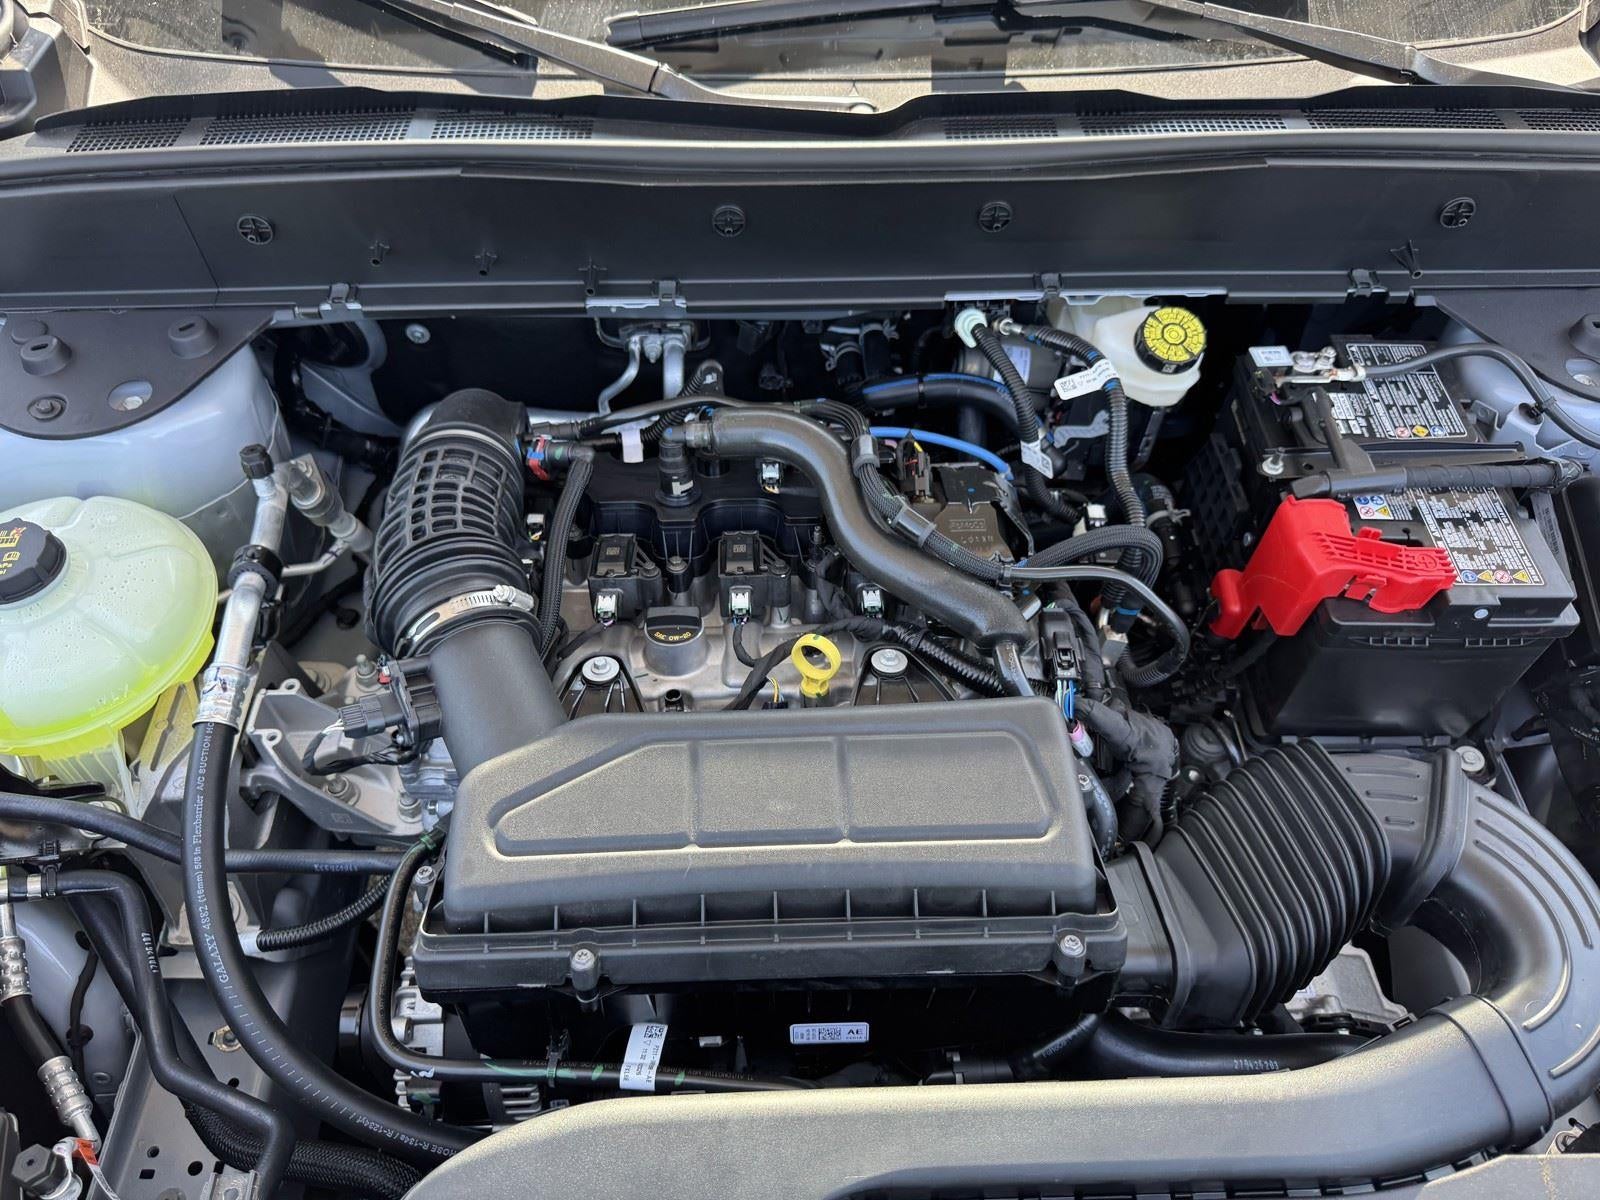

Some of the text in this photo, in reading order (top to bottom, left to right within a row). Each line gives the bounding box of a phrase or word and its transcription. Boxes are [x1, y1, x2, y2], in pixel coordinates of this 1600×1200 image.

[654, 631, 667, 641] SAE
[198, 735, 213, 775] SUCTION
[196, 776, 206, 791] A/C
[193, 794, 204, 844] Flexbarrier
[193, 846, 201, 855] in
[204, 933, 229, 983] GALAXY
[356, 1115, 394, 1138] R-1234yf
[399, 1134, 430, 1150] R-134a
